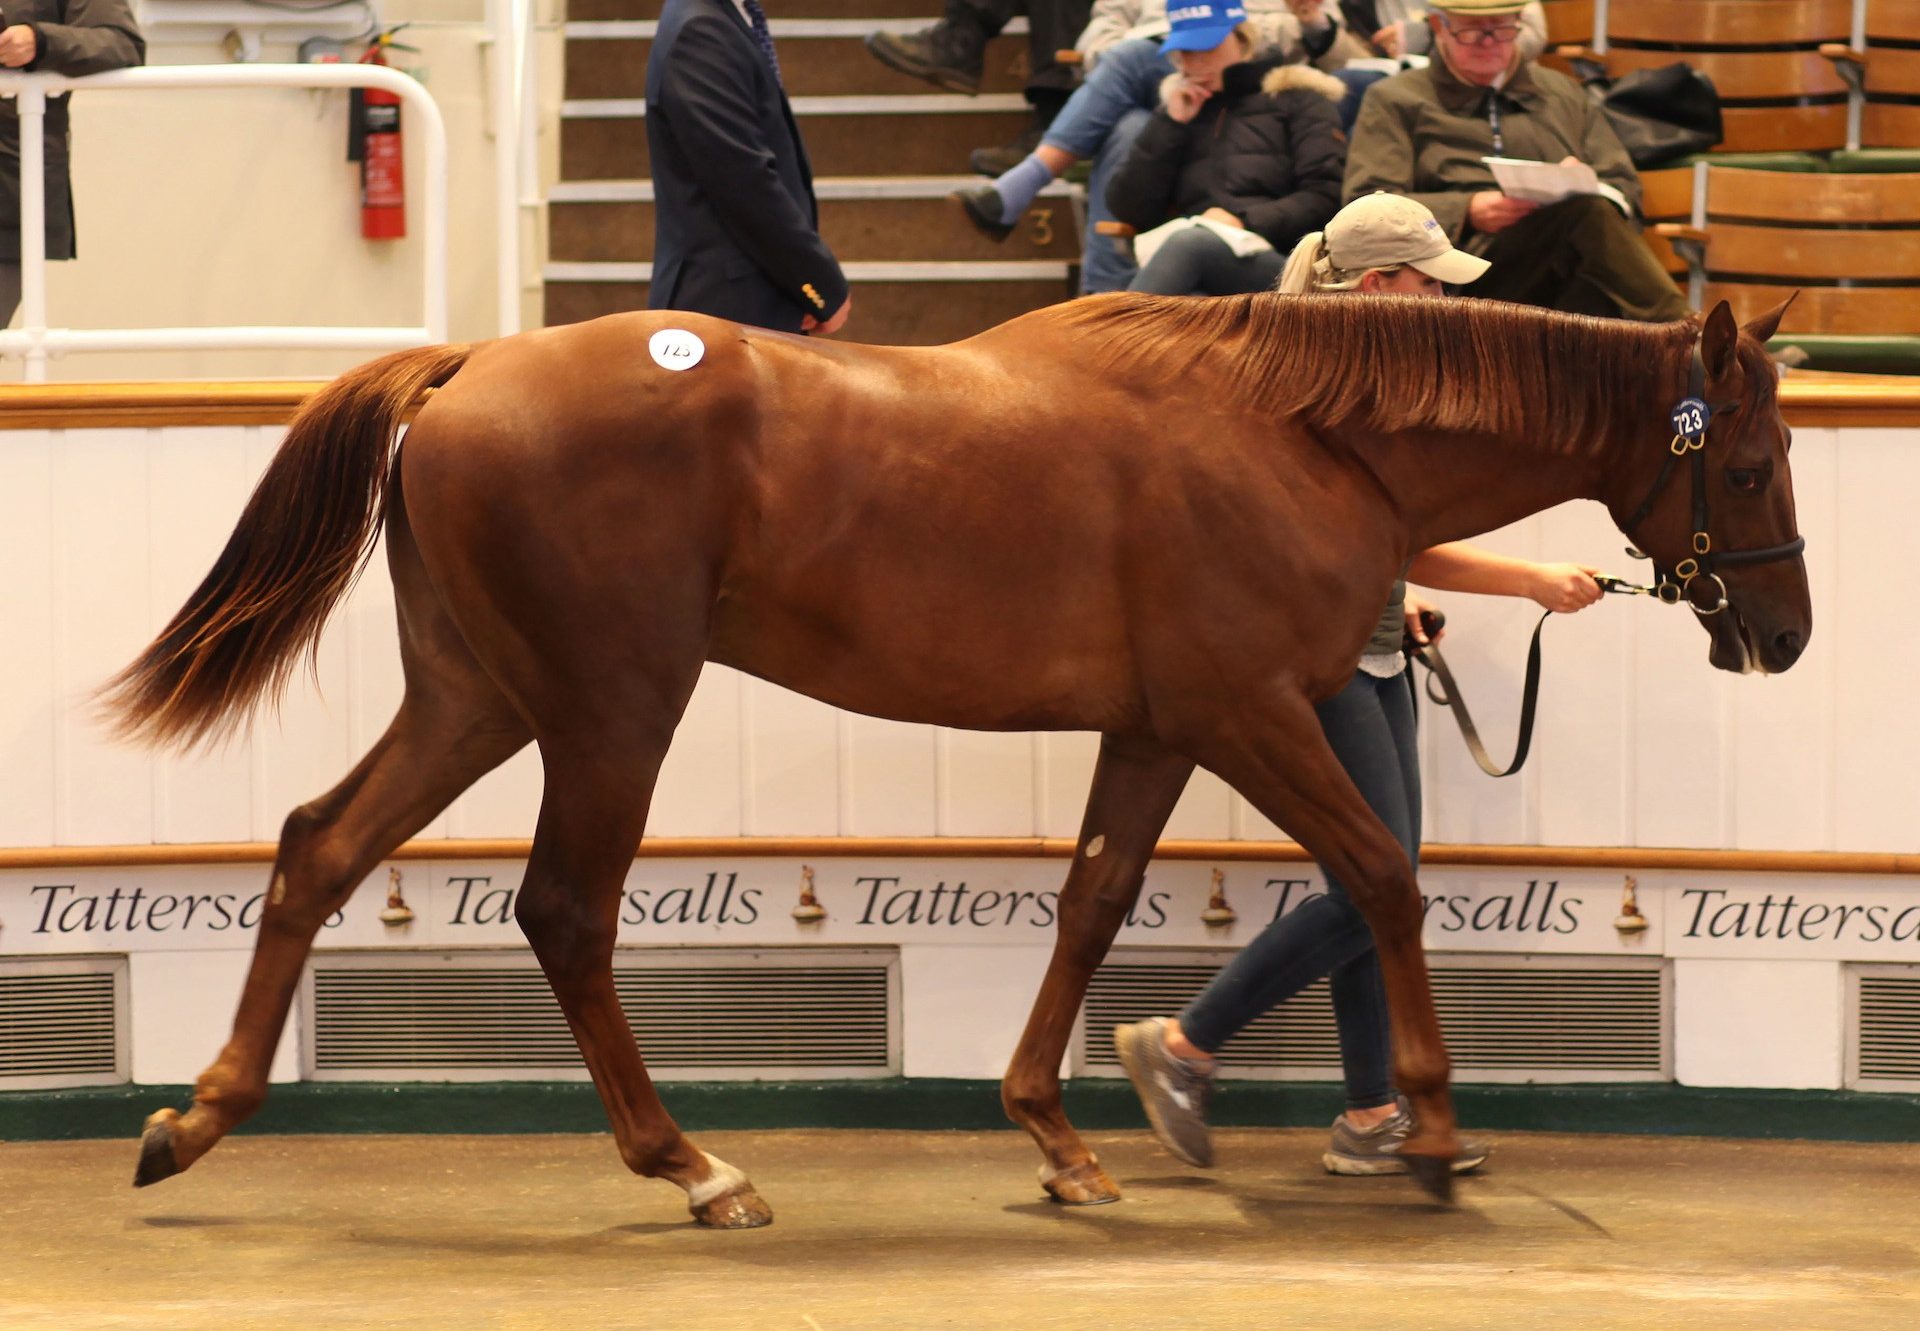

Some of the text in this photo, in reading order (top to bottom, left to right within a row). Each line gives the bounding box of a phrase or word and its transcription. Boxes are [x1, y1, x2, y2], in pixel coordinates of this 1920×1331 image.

[1028, 208, 1054, 246] 3
[1673, 408, 1703, 436] 723
[30, 884, 345, 934] Tattersas
[446, 871, 763, 926] Tasalls
[1265, 879, 1584, 934] Trsalls
